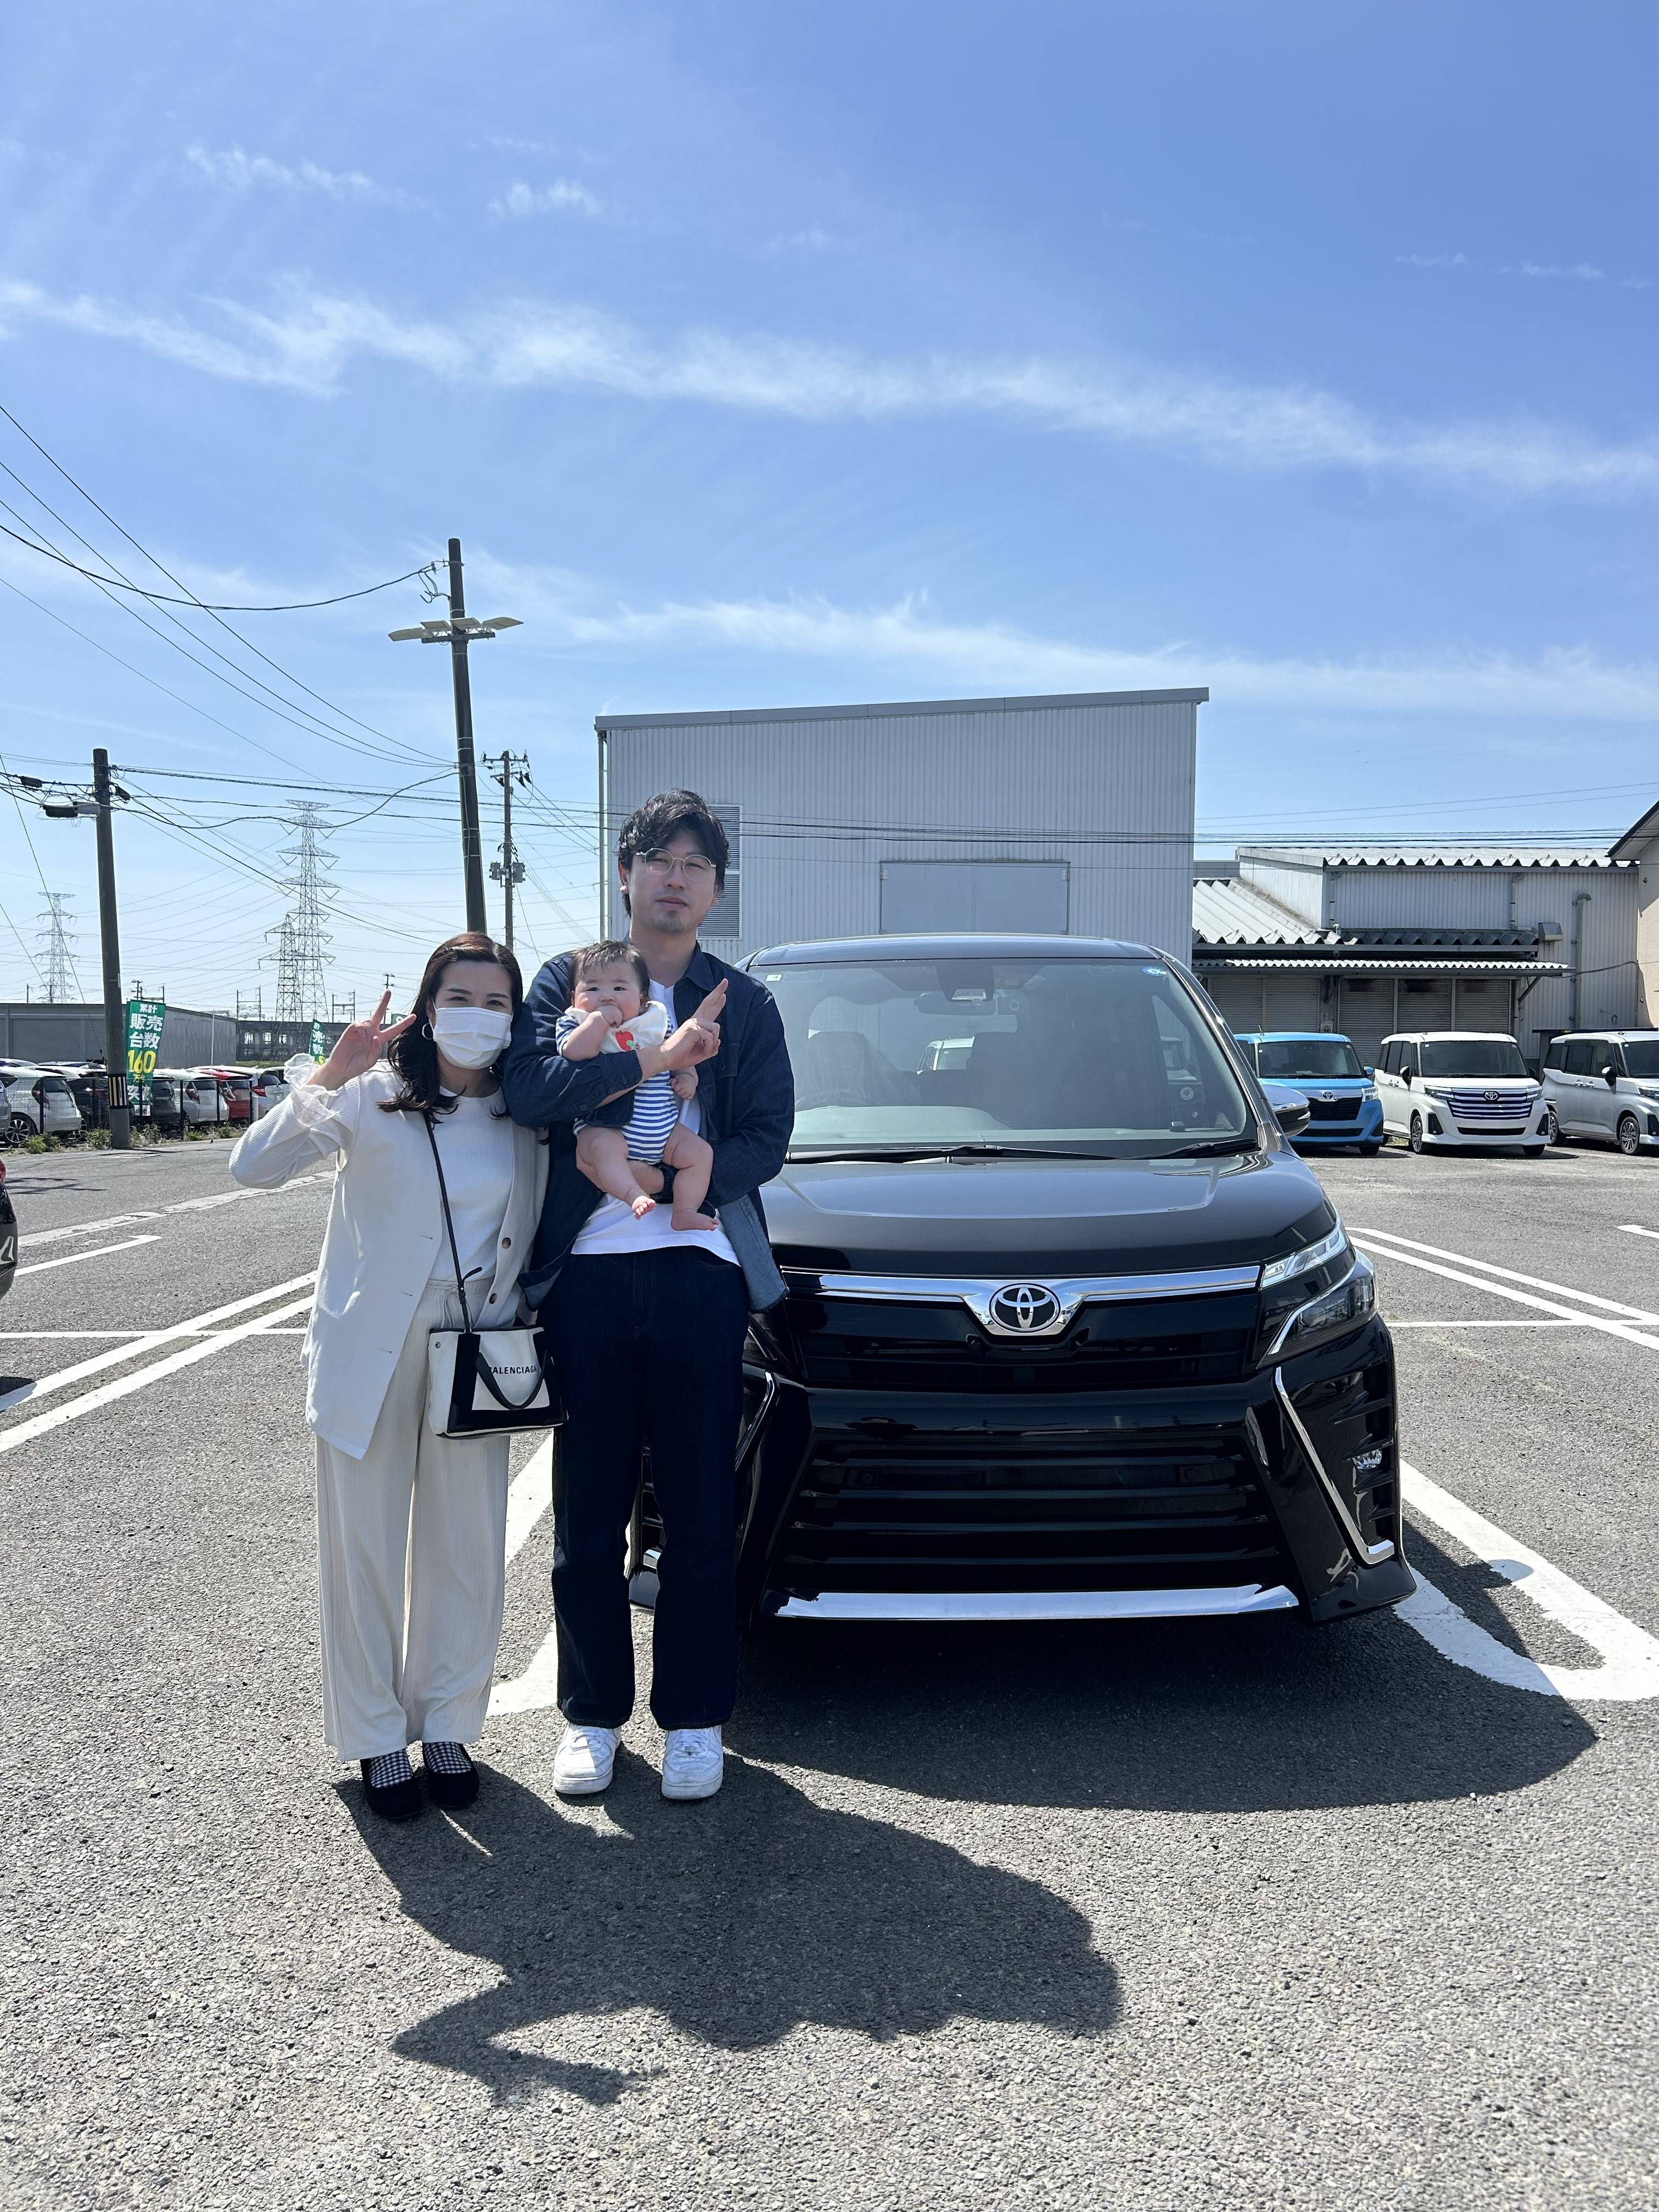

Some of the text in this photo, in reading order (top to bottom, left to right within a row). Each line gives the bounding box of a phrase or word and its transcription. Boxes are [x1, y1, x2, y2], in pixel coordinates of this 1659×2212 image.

[139, 1003, 157, 1014] 累計
[129, 1013, 163, 1032] 販売
[129, 1031, 161, 1049] 台数
[128, 1049, 156, 1074] 160
[490, 1364, 537, 1374] ALENCIAGA
